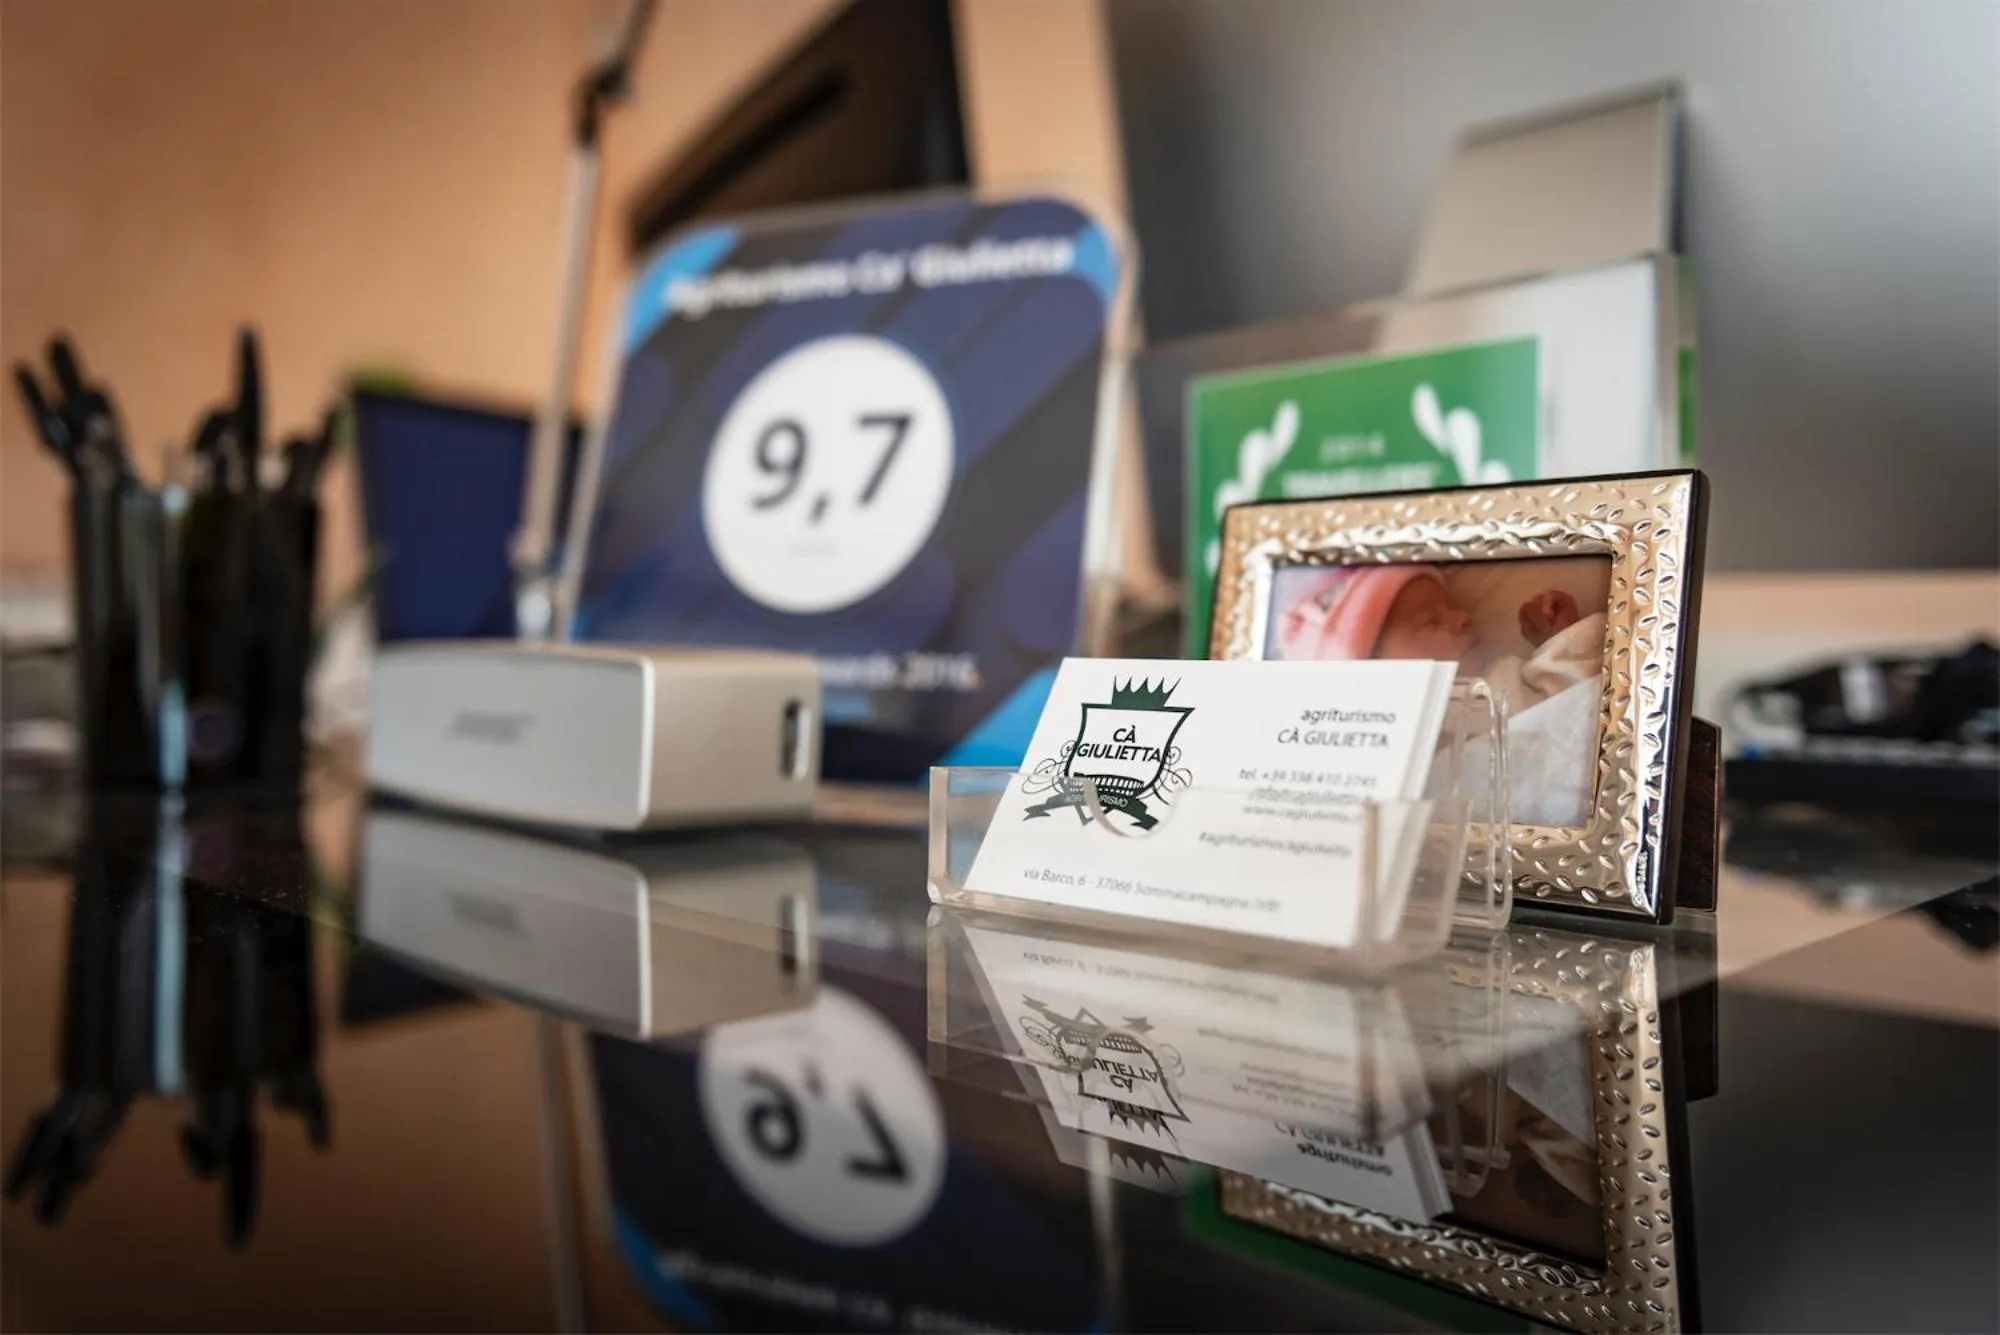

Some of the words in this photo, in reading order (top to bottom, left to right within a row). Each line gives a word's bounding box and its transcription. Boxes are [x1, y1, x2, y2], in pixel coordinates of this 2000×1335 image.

[750, 412, 913, 525] 9,7
[1300, 709, 1396, 724] agriturismo
[1113, 725, 1136, 743] CÀ
[1277, 727, 1299, 744] CÀ
[1304, 730, 1389, 748] GIULIETTA
[1077, 743, 1161, 763] GIULIETTA
[1024, 868, 1040, 880] via
[1041, 869, 1075, 886] Barco,
